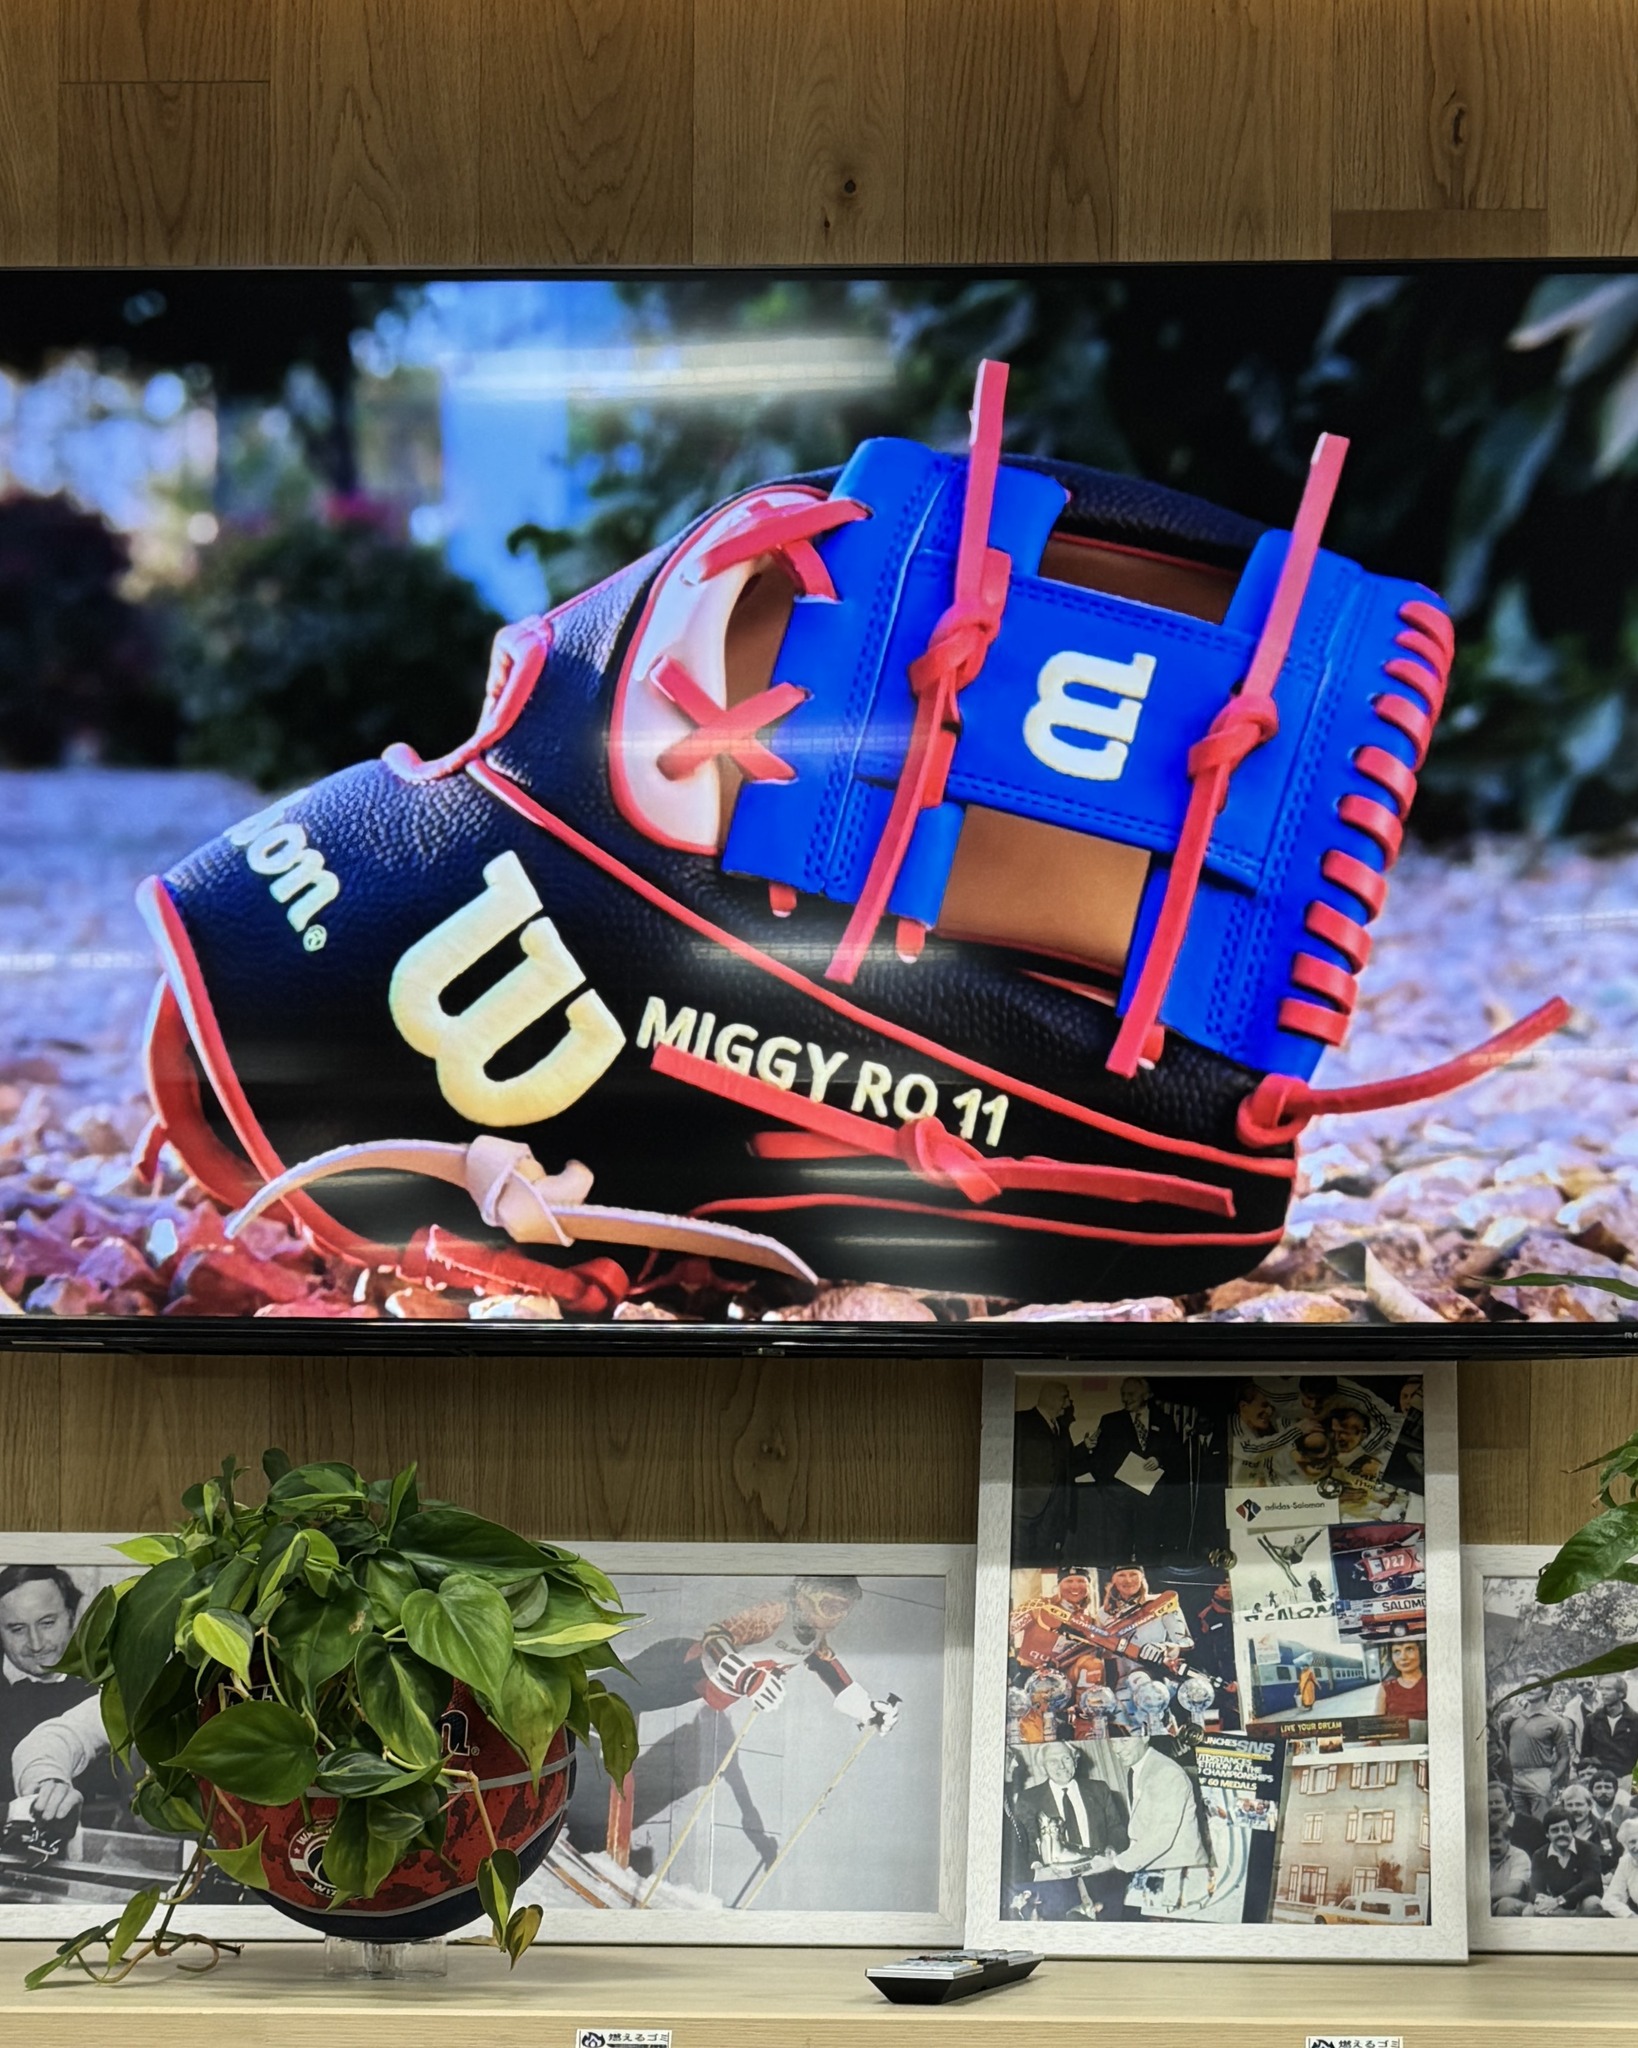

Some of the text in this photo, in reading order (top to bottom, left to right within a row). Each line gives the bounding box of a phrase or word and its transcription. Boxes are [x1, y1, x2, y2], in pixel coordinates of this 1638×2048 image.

[636, 995, 1010, 1148] MIGGY RO 11
[1280, 1721, 1343, 1733] LIVE YOUR DREAM
[1236, 1740, 1276, 1755] SNS
[1246, 1766, 1263, 1774] THE
[1207, 1778, 1219, 1787] 60
[1220, 1779, 1258, 1791] MEDALS
